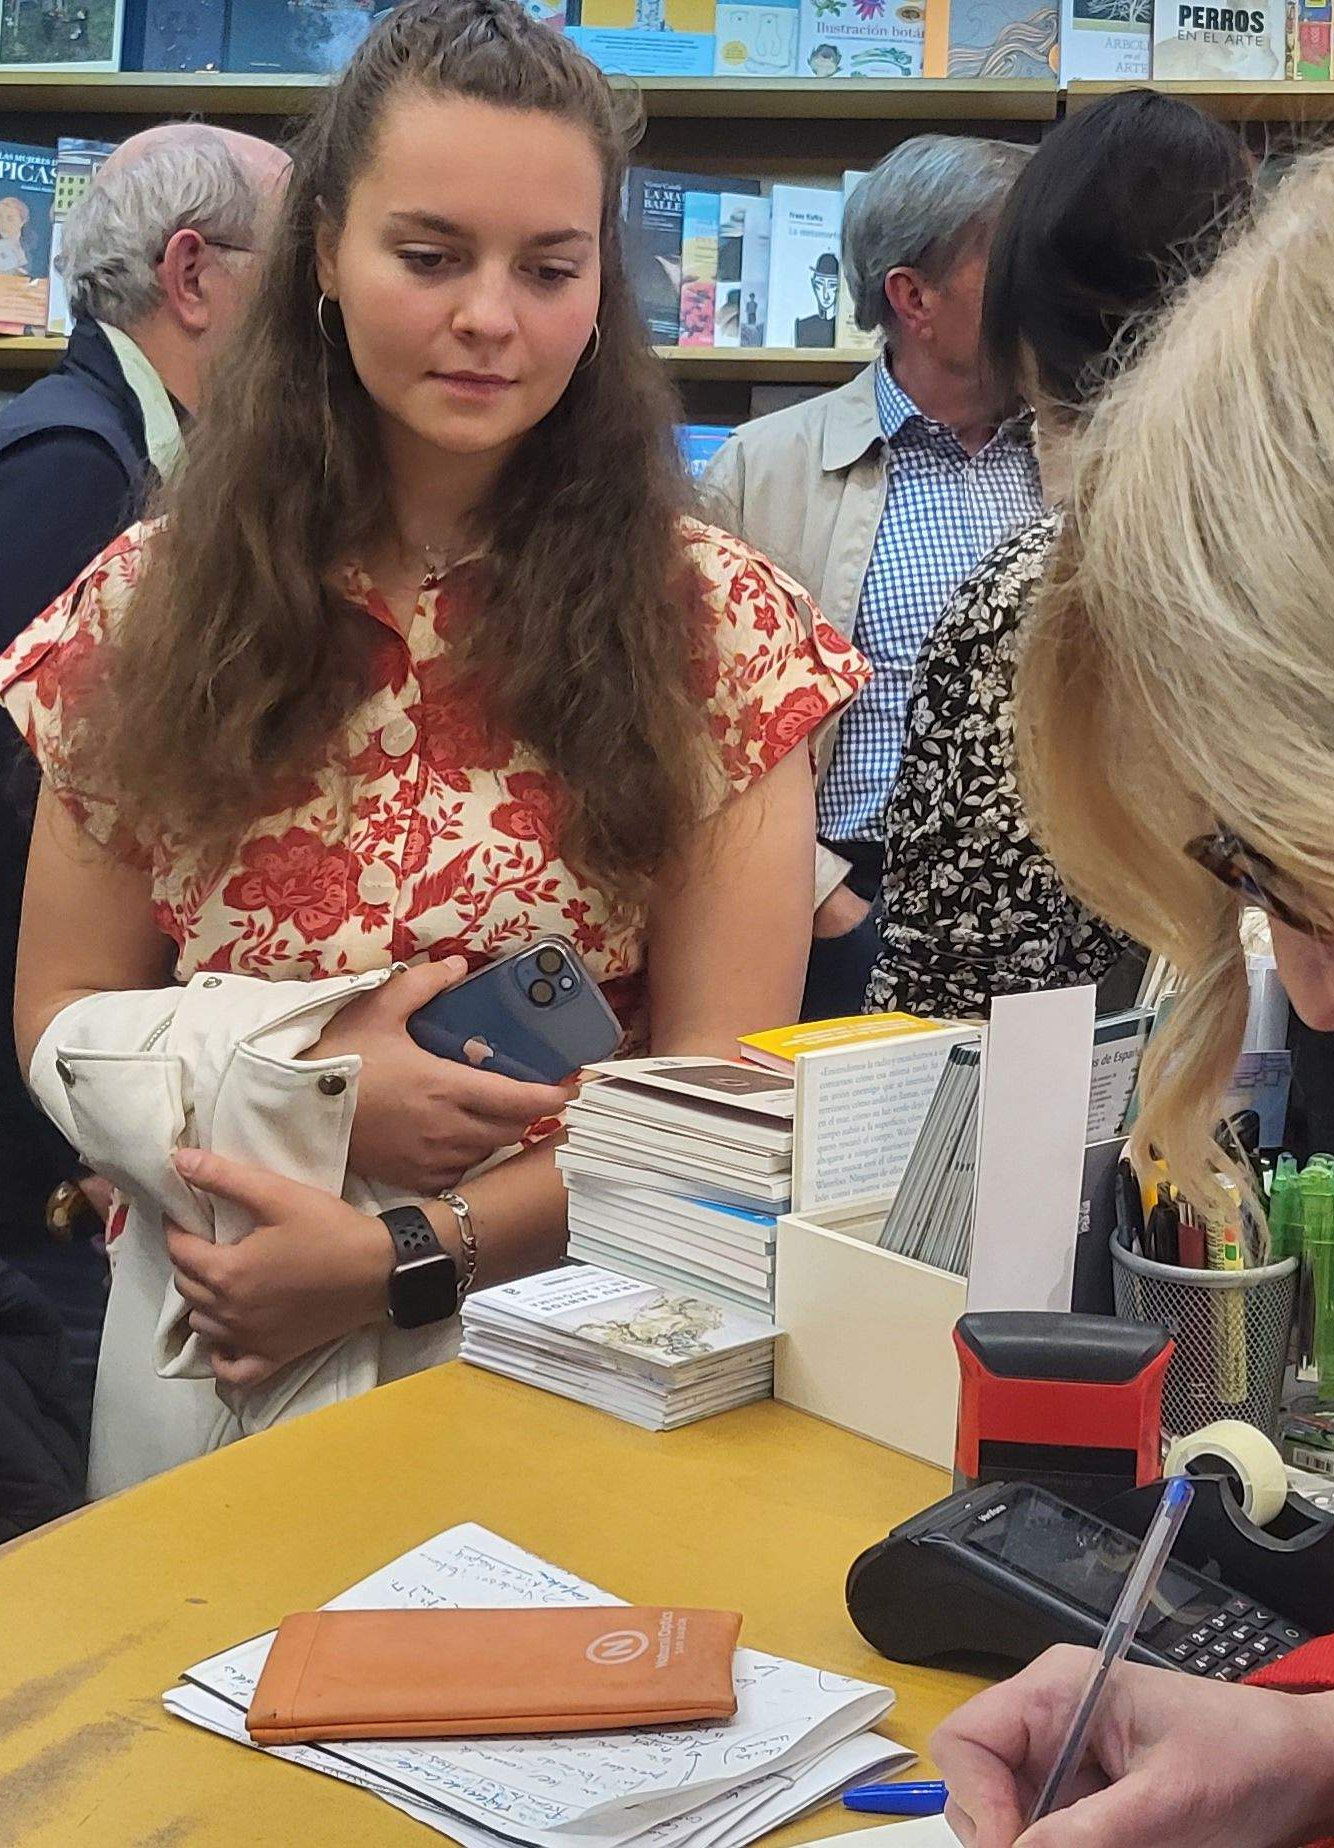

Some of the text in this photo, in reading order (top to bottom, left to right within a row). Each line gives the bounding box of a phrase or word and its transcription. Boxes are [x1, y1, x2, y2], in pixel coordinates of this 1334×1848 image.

[816, 21, 888, 38] Ilustración
[1178, 5, 1264, 33] PERROS
[1177, 30, 1263, 47] EN EL ARTE
[1100, 1053, 1112, 1066] de
[1174, 1616, 1225, 1656] 1 2 3
[1195, 1629, 1245, 1669] 4 5 6
[1234, 1656, 1248, 1667] 8
[1253, 1641, 1266, 1652] 9
